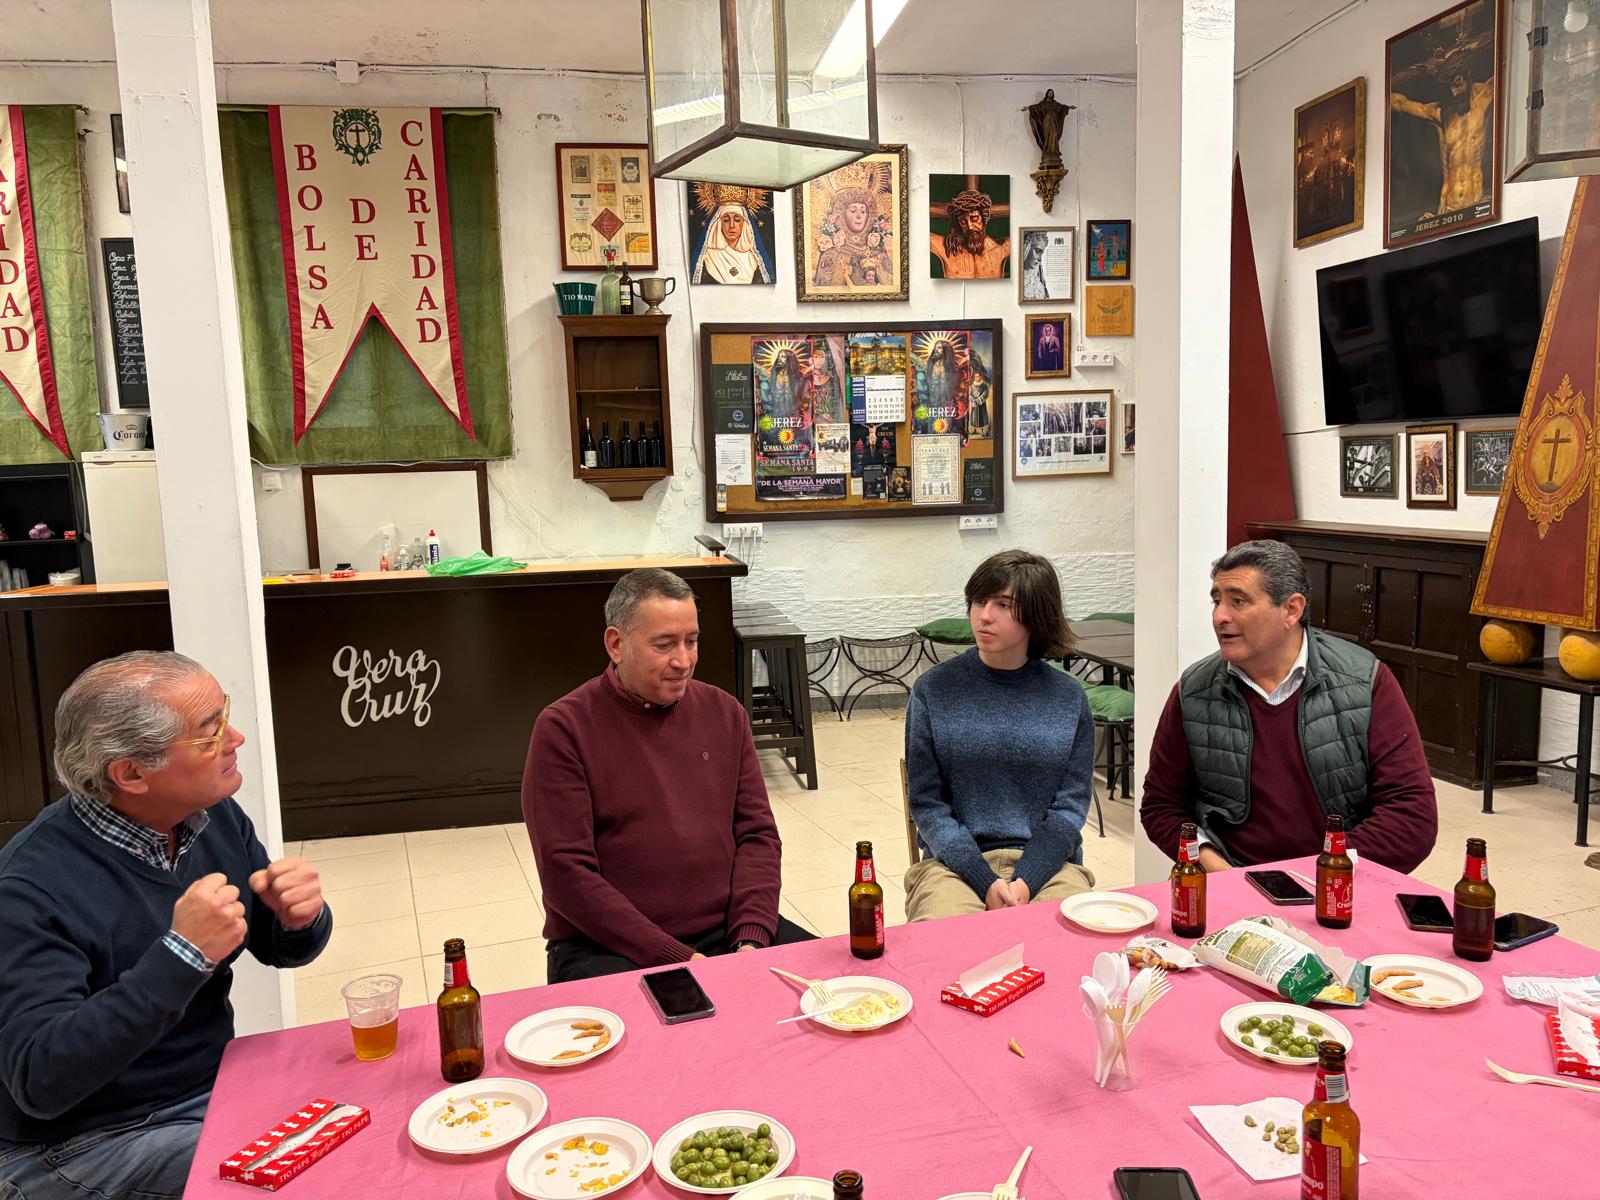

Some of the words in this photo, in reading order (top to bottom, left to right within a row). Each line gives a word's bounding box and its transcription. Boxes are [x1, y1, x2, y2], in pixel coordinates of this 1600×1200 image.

[349, 198, 378, 261] DE
[401, 120, 441, 344] CARIDAD
[1415, 219, 1439, 233] JEREZ
[1443, 213, 1463, 225] 2010
[294, 144, 334, 330] BOLSA
[577, 294, 595, 302] MATE
[927, 406, 957, 418] JEREZ
[772, 417, 802, 428] JEREZ
